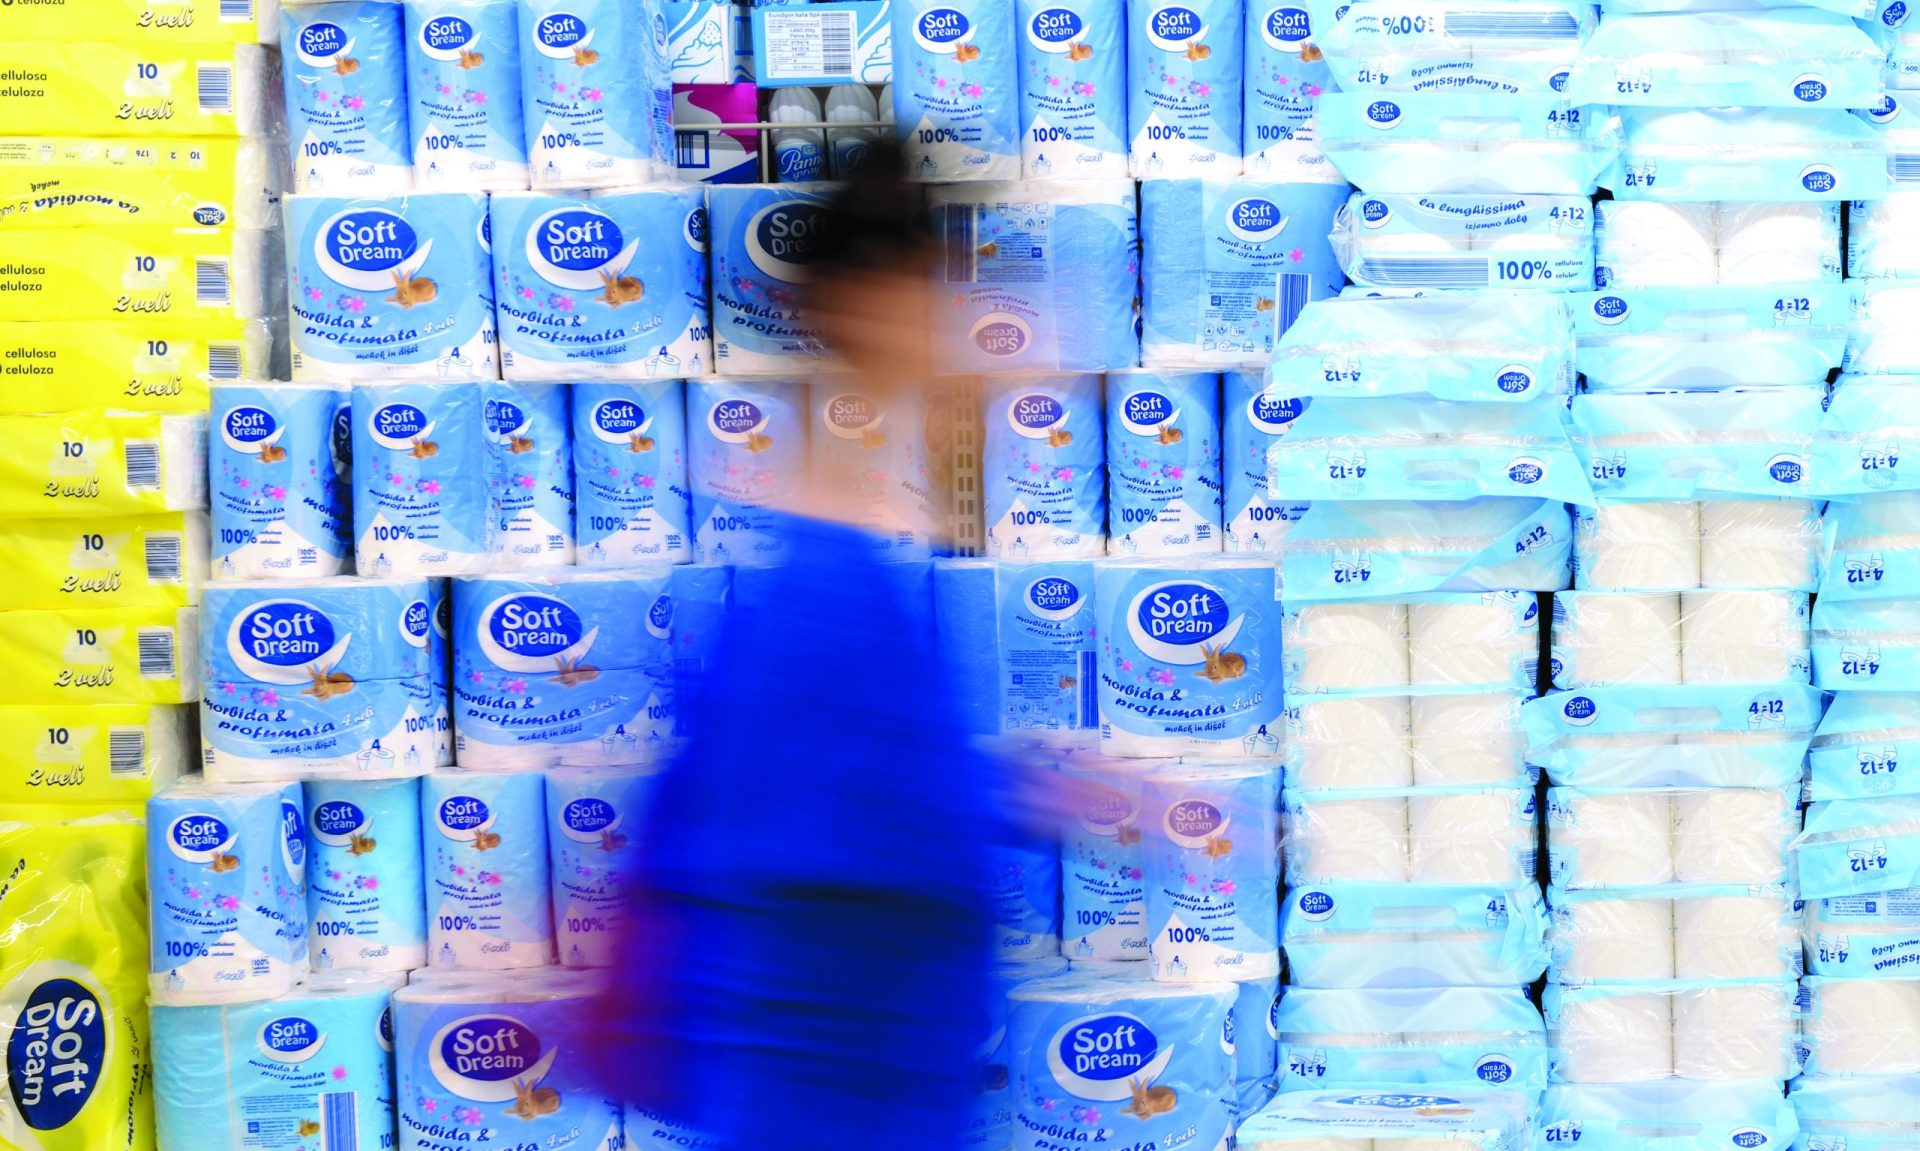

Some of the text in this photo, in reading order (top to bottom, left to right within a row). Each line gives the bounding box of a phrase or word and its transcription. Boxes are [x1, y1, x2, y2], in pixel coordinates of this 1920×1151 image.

[137, 7, 194, 27] 2 veli
[925, 14, 958, 29] Soft
[1039, 14, 1071, 29] Soft
[1157, 12, 1190, 26] Soft
[1273, 12, 1305, 26] Soft
[429, 21, 462, 36] Soft
[543, 18, 575, 34] Soft
[927, 28, 960, 38] Dream
[1040, 27, 1073, 38] Dream
[1158, 26, 1192, 36] Dream
[1273, 26, 1307, 36] Dream
[304, 28, 336, 43] Soft
[431, 35, 464, 46] Dream
[545, 32, 578, 44] Dream
[306, 42, 339, 53] Dream
[137, 63, 157, 79] 10
[1372, 104, 1394, 114] Soft
[919, 128, 958, 144] 100%
[1148, 126, 1185, 140] 100%
[426, 135, 463, 150] 100%
[781, 149, 823, 174] Pann
[1238, 203, 1271, 218] Soft
[1439, 199, 1526, 217] lunghissima
[1239, 216, 1272, 228] Dream
[337, 219, 397, 246] Soft
[547, 219, 604, 245] Soft
[339, 246, 402, 264] Dream
[549, 244, 608, 263] Dream
[135, 256, 156, 272] 10
[1497, 261, 1552, 280] 100%
[114, 292, 171, 312] 2 veli
[1599, 300, 1620, 309] Soft
[292, 303, 373, 328] morbida &
[500, 302, 582, 327] morbida &
[305, 327, 417, 344] profumata
[517, 326, 625, 343] profumata
[148, 340, 168, 356] 10
[659, 346, 668, 357] 4
[986, 338, 1018, 350] Soft
[5, 348, 56, 359] cellulosa
[451, 347, 460, 359] 4
[6, 364, 54, 375] celuloza
[601, 405, 634, 419] Soft
[1019, 400, 1052, 414] Soft
[1129, 397, 1162, 412] Soft
[231, 412, 264, 427] Soft
[380, 409, 415, 424] Soft
[719, 406, 750, 419] Soft
[1021, 413, 1054, 423] Dream
[1131, 411, 1164, 421] Dream
[1259, 408, 1293, 420] Dream
[232, 425, 267, 437] Dream
[382, 423, 417, 435] Dream
[602, 418, 636, 429] Dream
[720, 418, 753, 429] Dream
[63, 441, 83, 458] 10
[44, 477, 99, 498] 2 veli
[1011, 511, 1050, 525] 100%
[1249, 507, 1288, 521] 100%
[591, 516, 627, 531] 100%
[83, 534, 104, 551] 10
[221, 529, 257, 544] 100%
[1037, 582, 1069, 596] Soft
[1038, 595, 1070, 605] Dream
[1150, 593, 1211, 618] Soft
[502, 603, 562, 630] Soft
[251, 612, 315, 639] Soft
[1152, 618, 1213, 636] Dream
[76, 629, 96, 645] 10
[503, 630, 568, 648] Dream
[253, 639, 319, 658] Dream
[54, 666, 114, 687] 2 veli
[1102, 673, 1183, 701] morbida &
[203, 697, 288, 722] morbida &
[1115, 698, 1226, 718] profumata
[1568, 700, 1589, 711] Soft
[467, 707, 581, 726] profumata
[48, 728, 69, 745] 10
[218, 720, 335, 739] profumata
[616, 724, 625, 735] 4
[1257, 724, 1267, 736] 4
[371, 738, 381, 751] 4
[320, 806, 353, 821] Soft
[445, 801, 478, 815] Soft
[570, 803, 604, 818] Soft
[1175, 806, 1210, 822] Soft
[321, 819, 356, 831] Dream
[447, 815, 481, 825] Dream
[571, 817, 607, 828] Dream
[1176, 820, 1212, 832] Dream
[180, 821, 217, 836] Soft
[181, 835, 220, 847] Dream
[1304, 895, 1327, 905] Soft
[317, 921, 354, 936] 100%
[567, 918, 605, 932] 100%
[1168, 927, 1209, 943] 100%
[271, 1022, 307, 1037] Soft
[272, 1036, 309, 1048] Dream
[453, 1028, 519, 1055] Soft
[1073, 1024, 1137, 1054] Soft
[21, 1002, 55, 1106] Dream
[51, 996, 97, 1098] Soft
[456, 1054, 524, 1074] Dream
[1076, 1052, 1141, 1074] Dream
[402, 1112, 490, 1142] morbida &
[1017, 1112, 1107, 1142] morbida &
